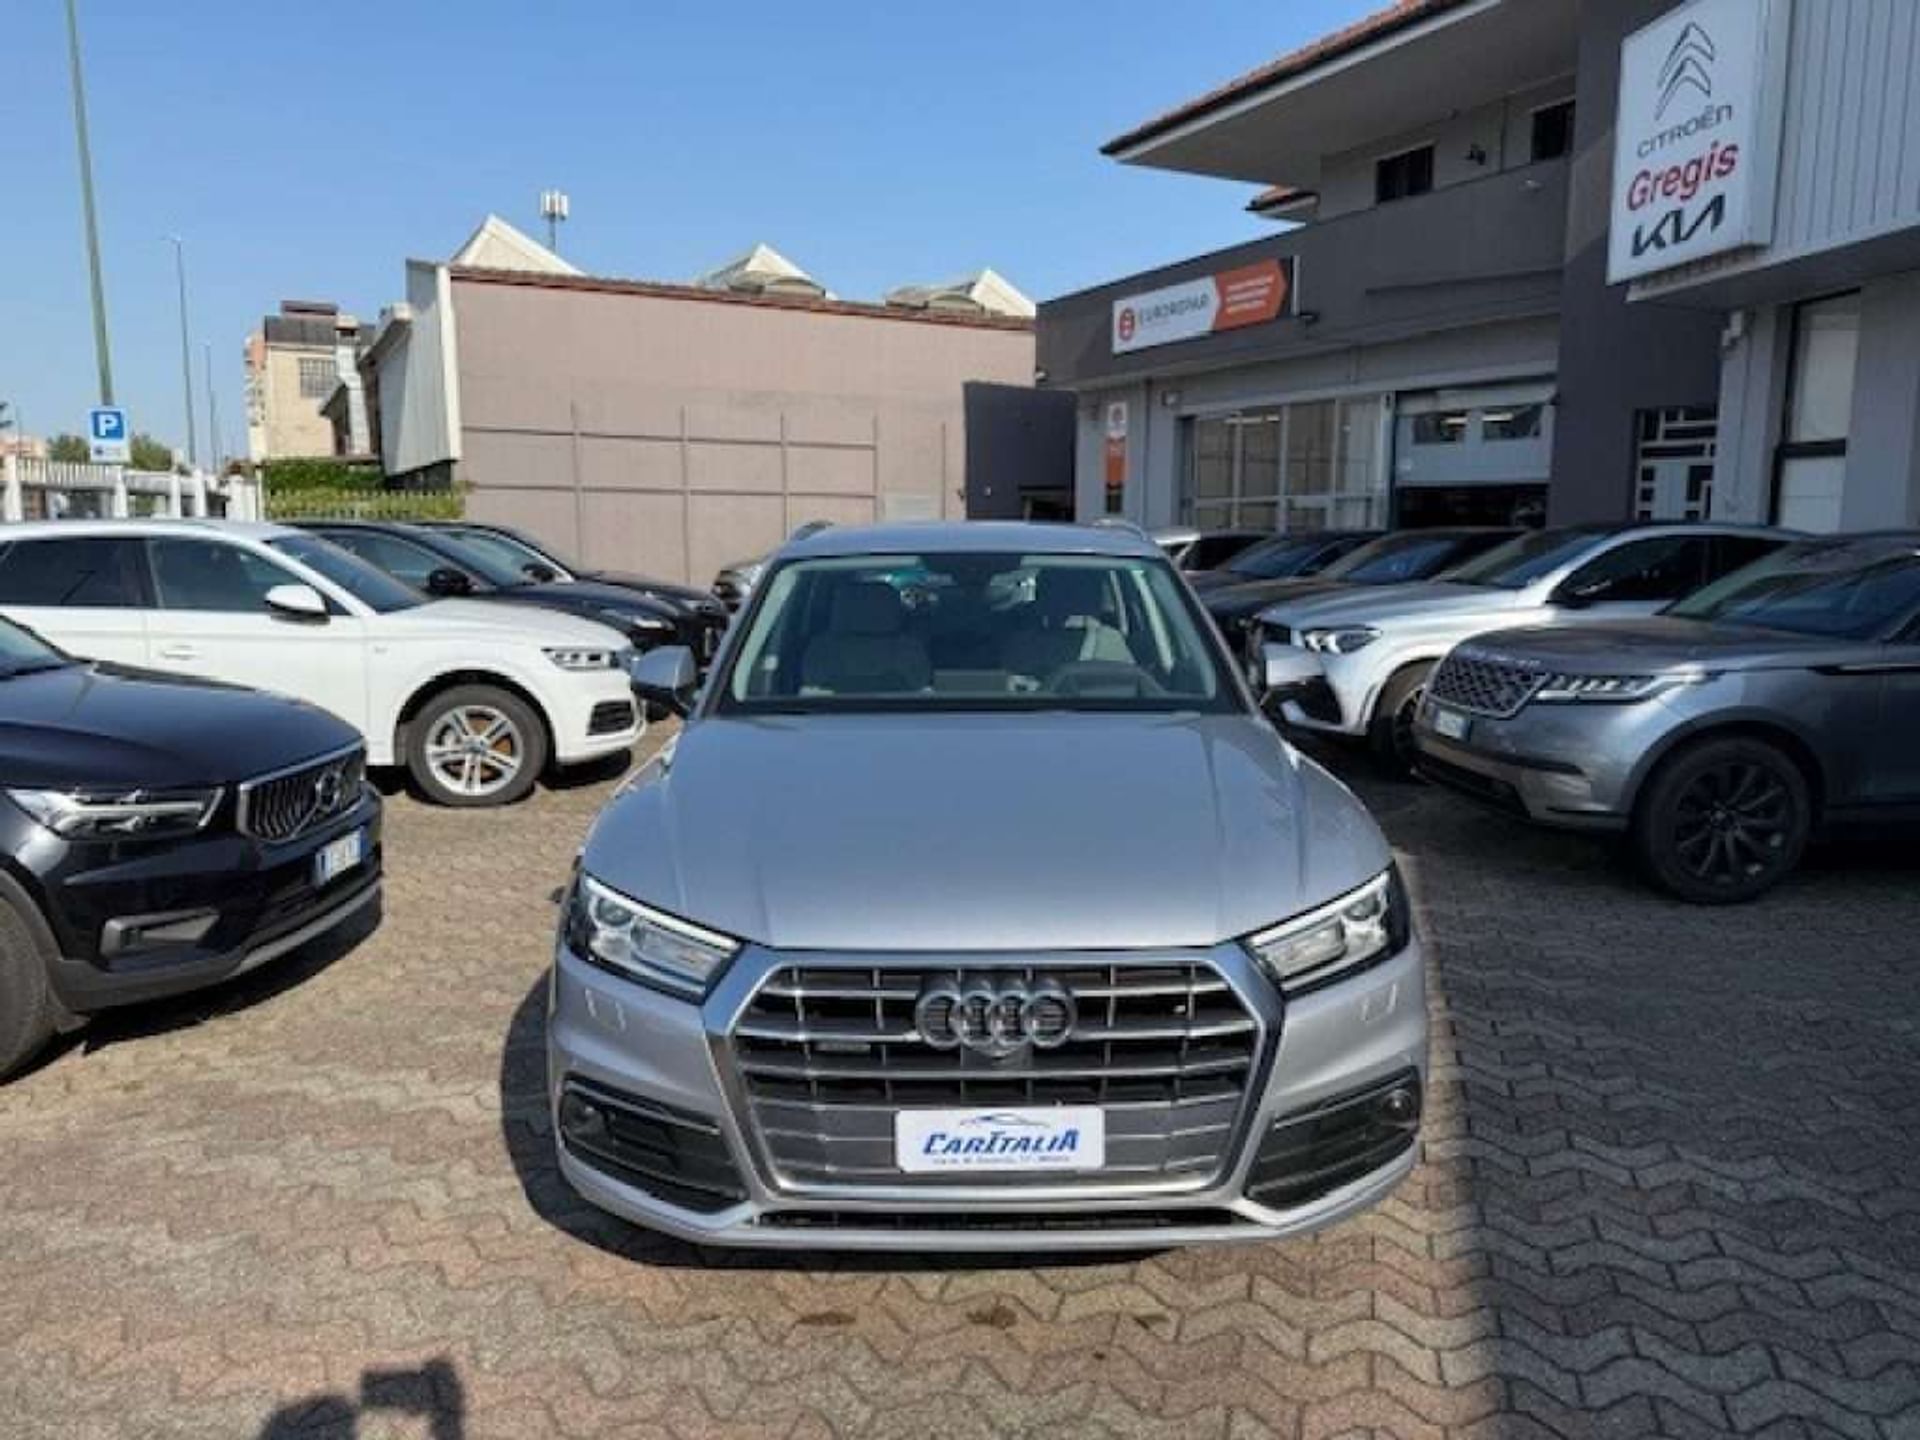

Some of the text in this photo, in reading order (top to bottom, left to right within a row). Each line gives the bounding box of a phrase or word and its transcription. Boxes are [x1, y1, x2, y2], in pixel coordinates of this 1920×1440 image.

[1627, 141, 1739, 211] Gregis
[1631, 194, 1726, 258] KIA
[99, 414, 118, 436] P
